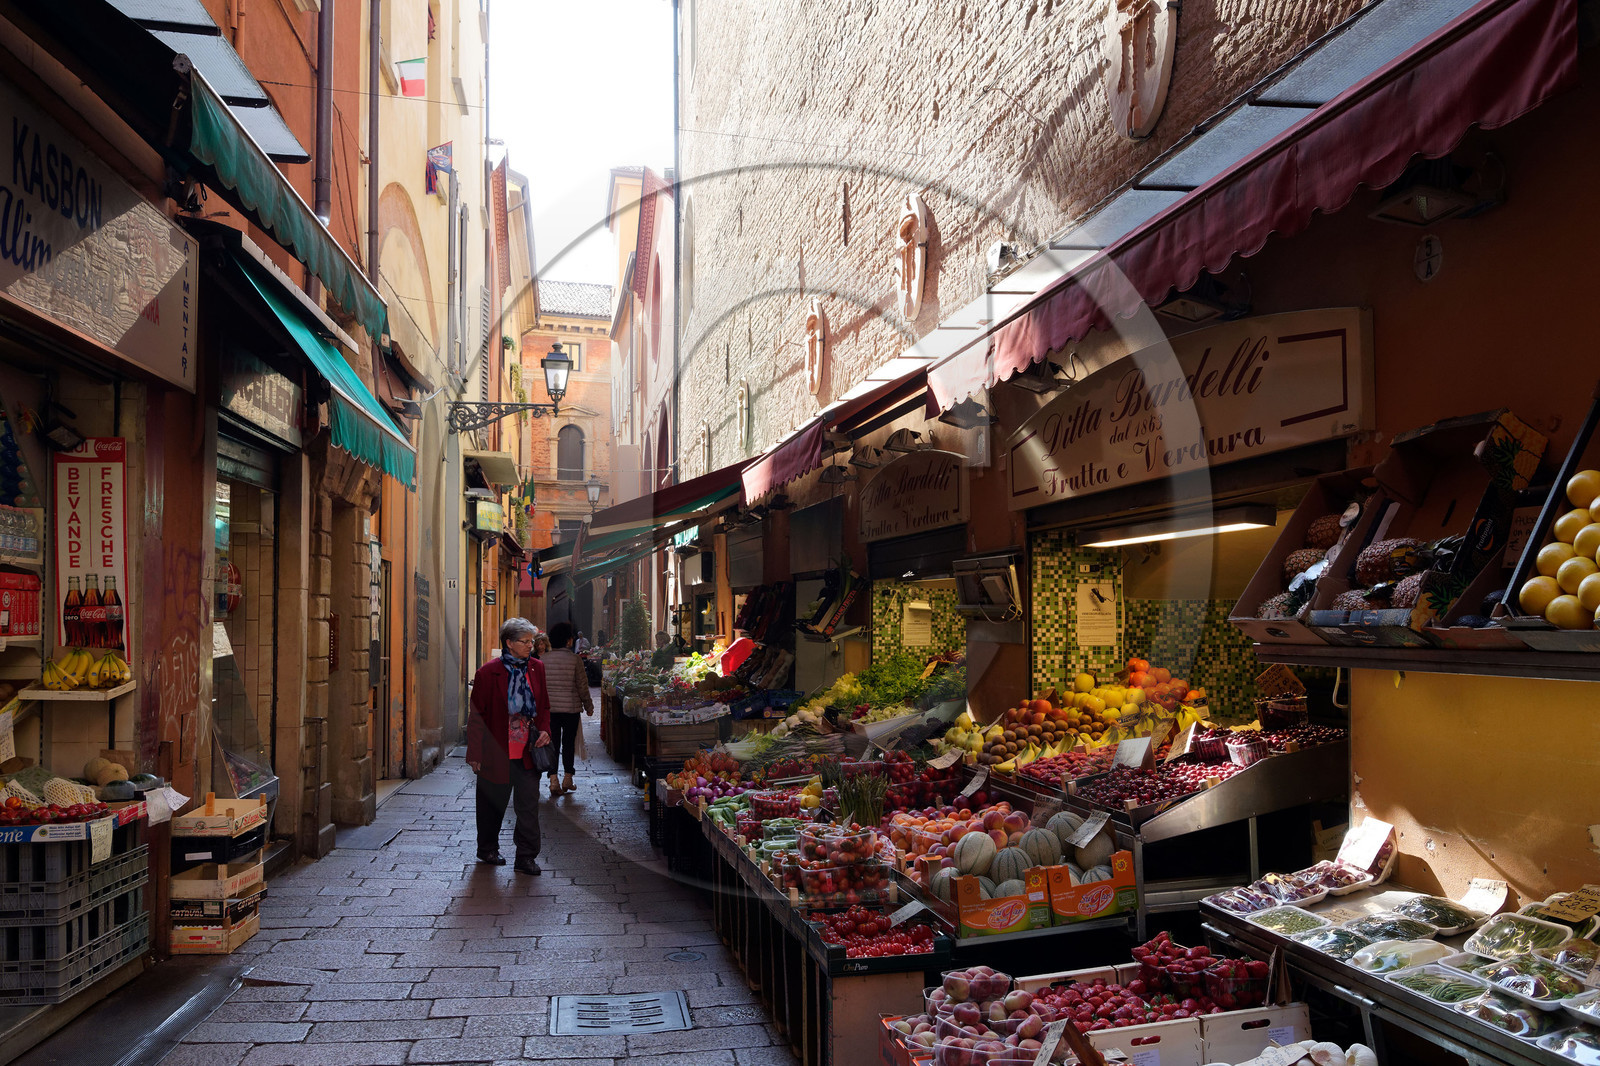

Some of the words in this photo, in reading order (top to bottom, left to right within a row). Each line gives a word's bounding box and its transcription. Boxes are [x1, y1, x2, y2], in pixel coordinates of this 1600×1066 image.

[12, 116, 102, 231] KASBON
[1041, 400, 1101, 462] Ditta
[1110, 335, 1270, 422] Bardelli
[1109, 420, 1131, 445] dal
[1135, 414, 1162, 437] 1863
[893, 459, 952, 497] Bardelli
[1043, 461, 1111, 497] Frutta
[1117, 462, 1129, 478] e
[1133, 426, 1265, 472] Verdura
[67, 467, 82, 569] BEVANDE
[101, 467, 114, 568] FRESCHE
[902, 506, 949, 529] Verdura
